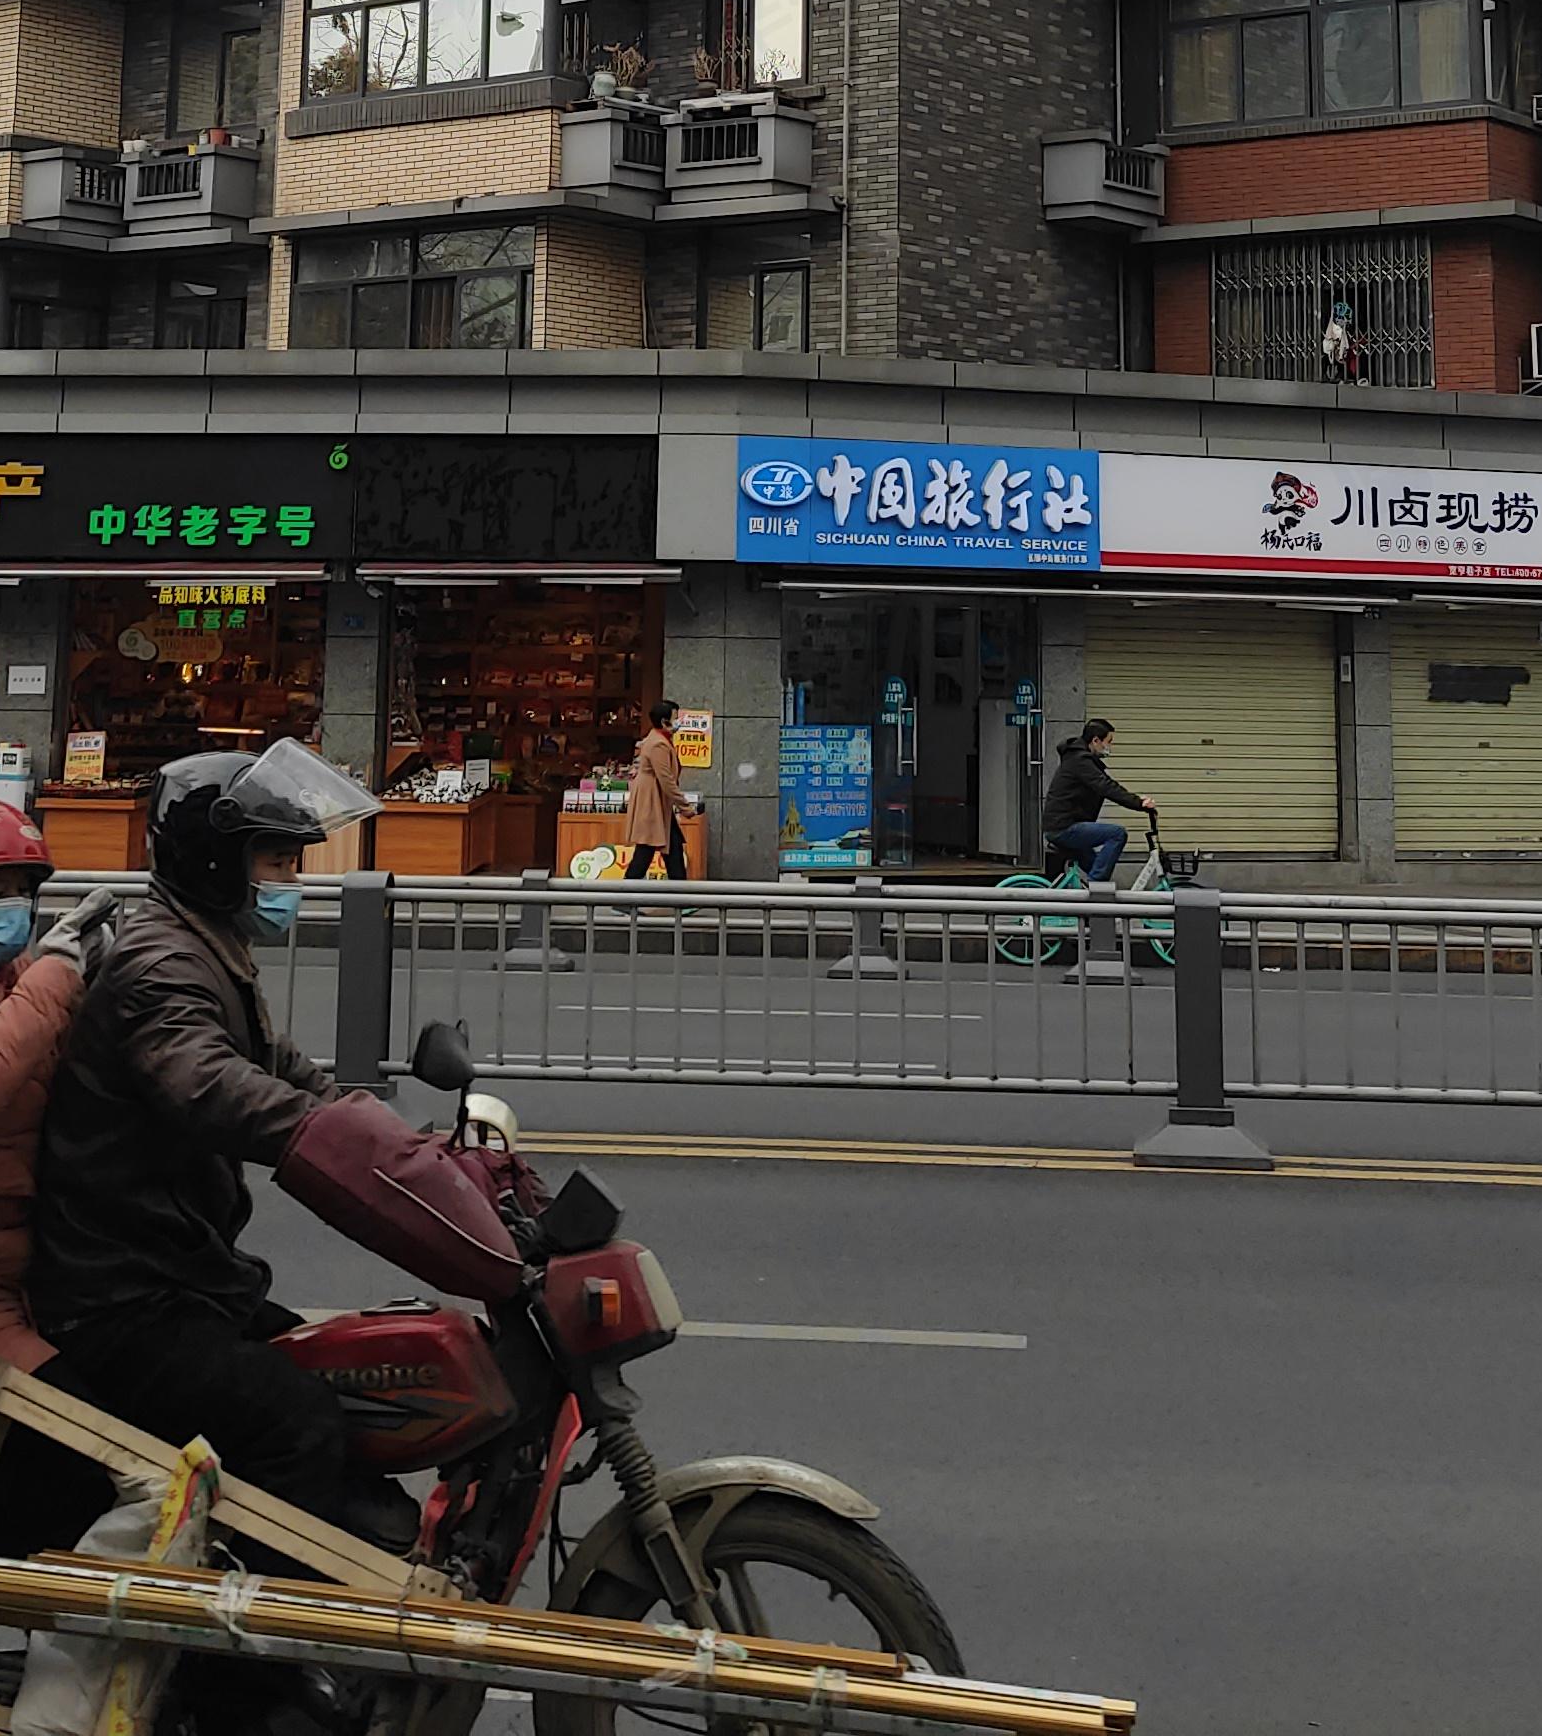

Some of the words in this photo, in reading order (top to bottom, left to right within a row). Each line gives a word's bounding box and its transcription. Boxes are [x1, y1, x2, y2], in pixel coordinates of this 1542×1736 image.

[815, 453, 1093, 533] 中国旅行社
[1330, 486, 1539, 534] 川卤现捞
[88, 504, 318, 547] 中华老字号
[748, 516, 801, 537] 四川省
[815, 531, 890, 546] SICHUAN
[895, 534, 948, 547] CHINA
[953, 536, 1014, 549] TRAVEL
[1020, 538, 1089, 551] SERVICE
[1260, 527, 1324, 552] 杨氏口福
[158, 585, 267, 606] 品知味火锅底料
[176, 609, 248, 629] 直营点
